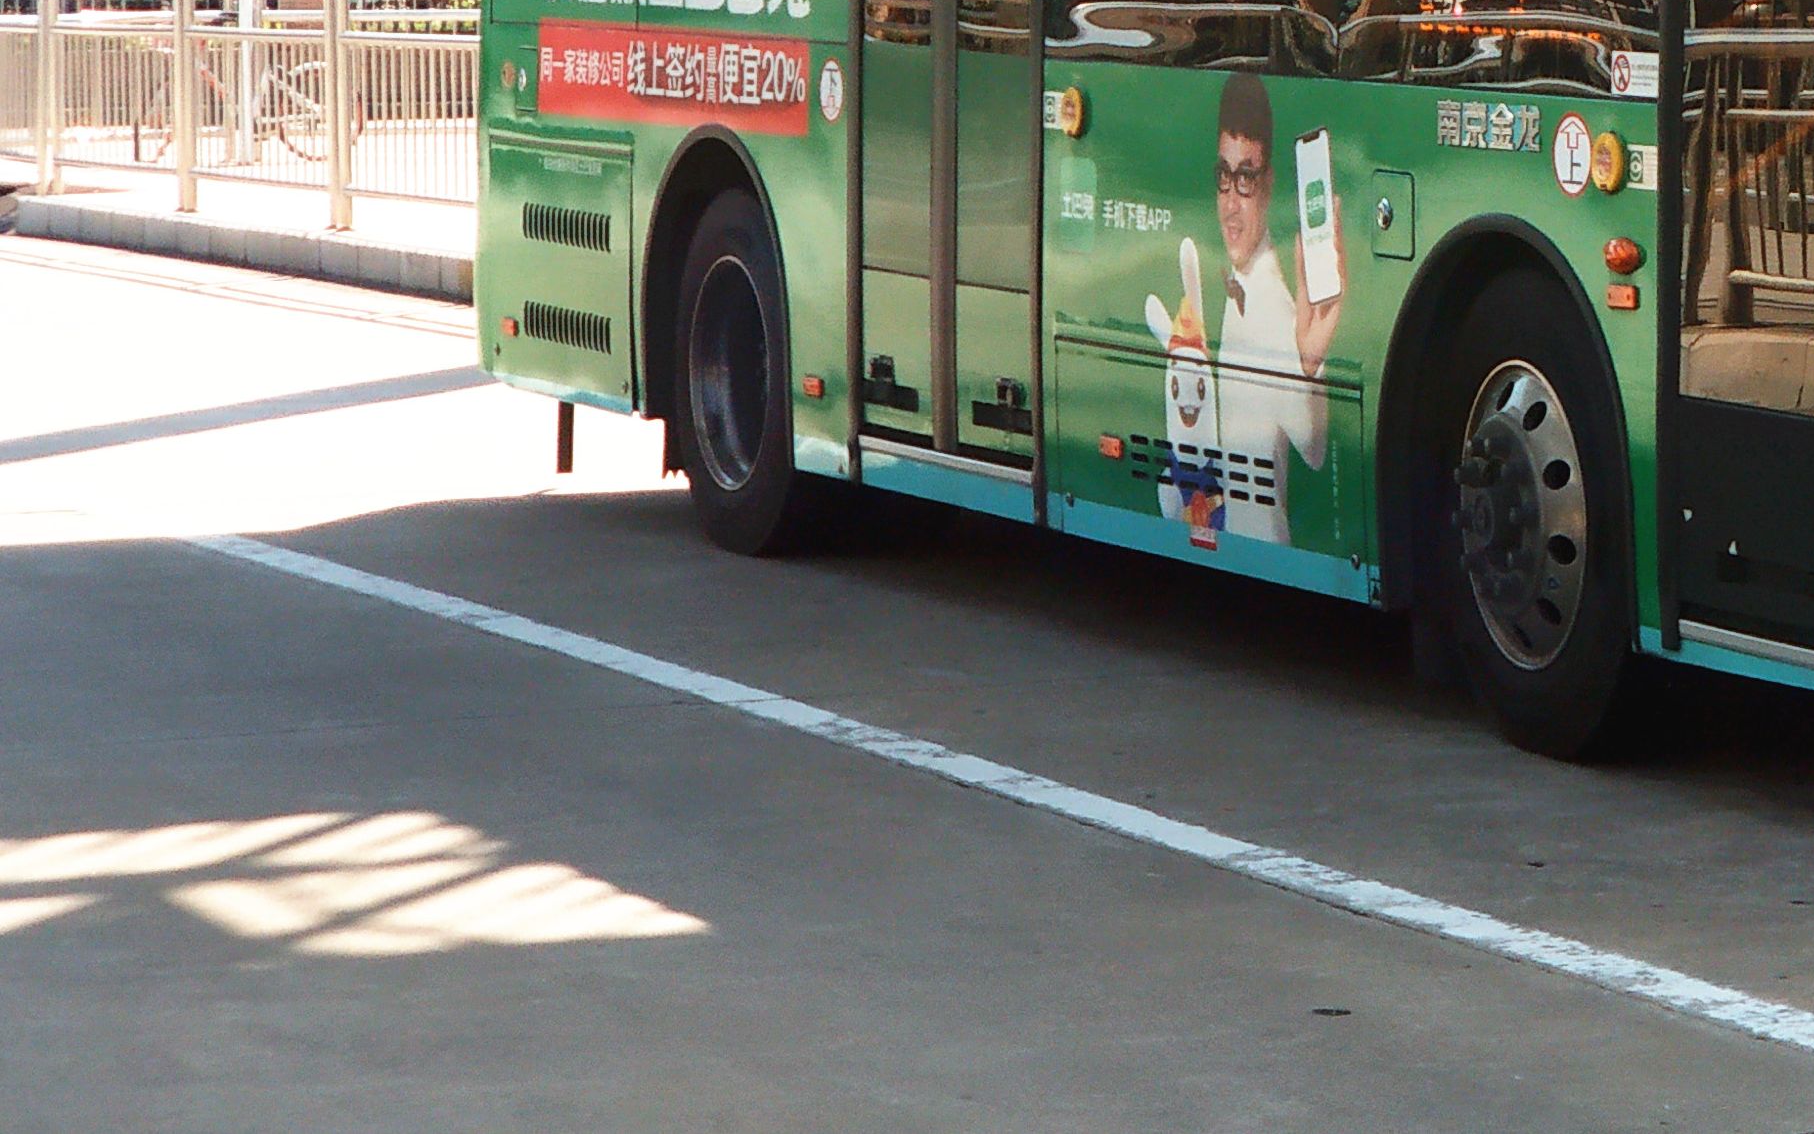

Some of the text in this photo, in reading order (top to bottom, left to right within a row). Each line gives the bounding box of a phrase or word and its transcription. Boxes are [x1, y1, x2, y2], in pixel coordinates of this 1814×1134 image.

[1437, 100, 1542, 152] 南京金龙
[1562, 149, 1583, 185] 上
[1061, 192, 1095, 220] 土巴兔
